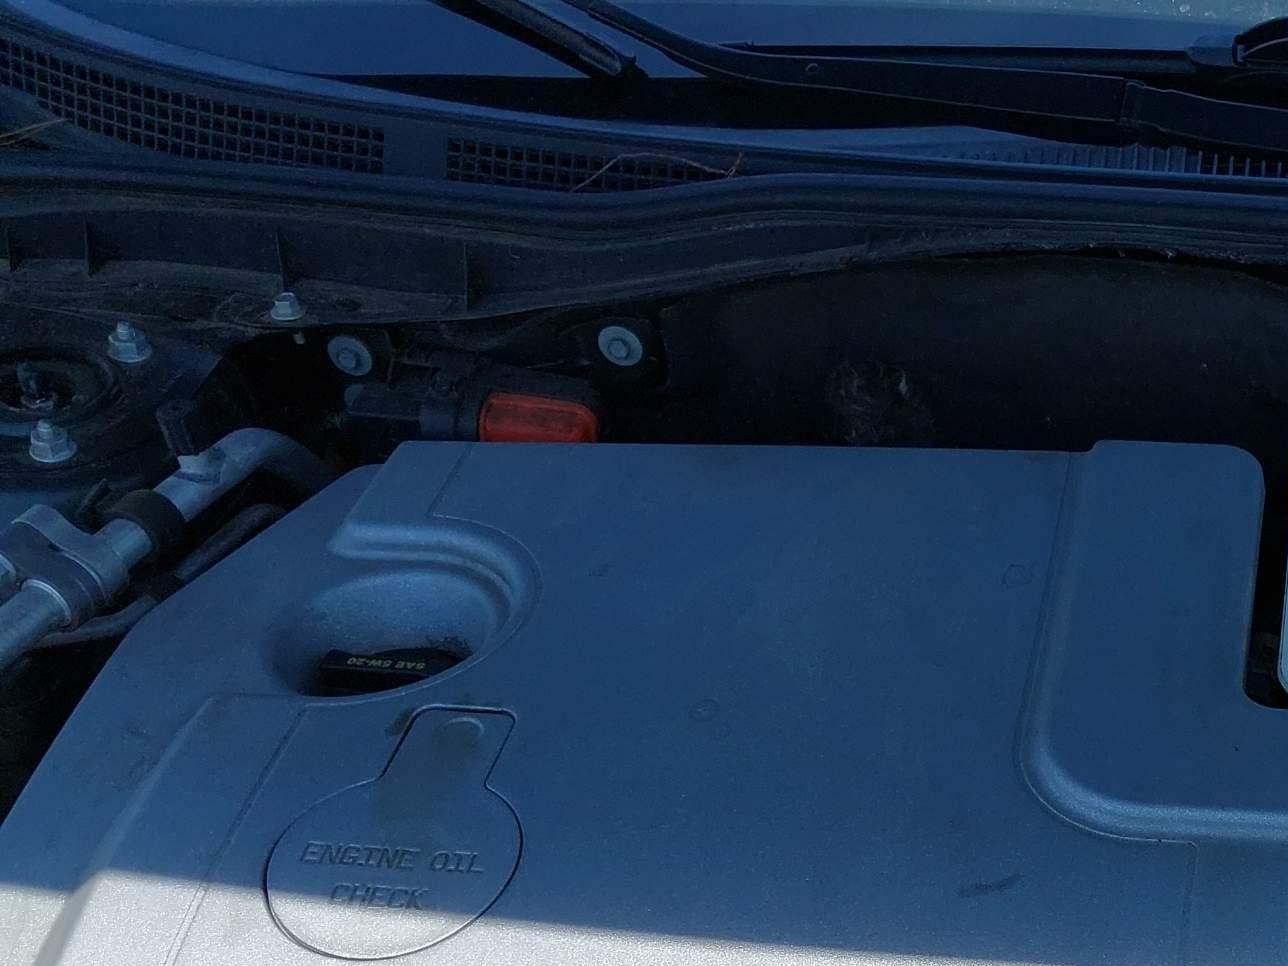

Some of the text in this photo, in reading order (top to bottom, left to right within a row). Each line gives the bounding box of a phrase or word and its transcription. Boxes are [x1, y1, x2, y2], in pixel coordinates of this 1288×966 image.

[346, 656, 425, 670] SAE 5W-20
[299, 840, 486, 876] ENGINE OIL
[328, 883, 429, 911] CHECK
